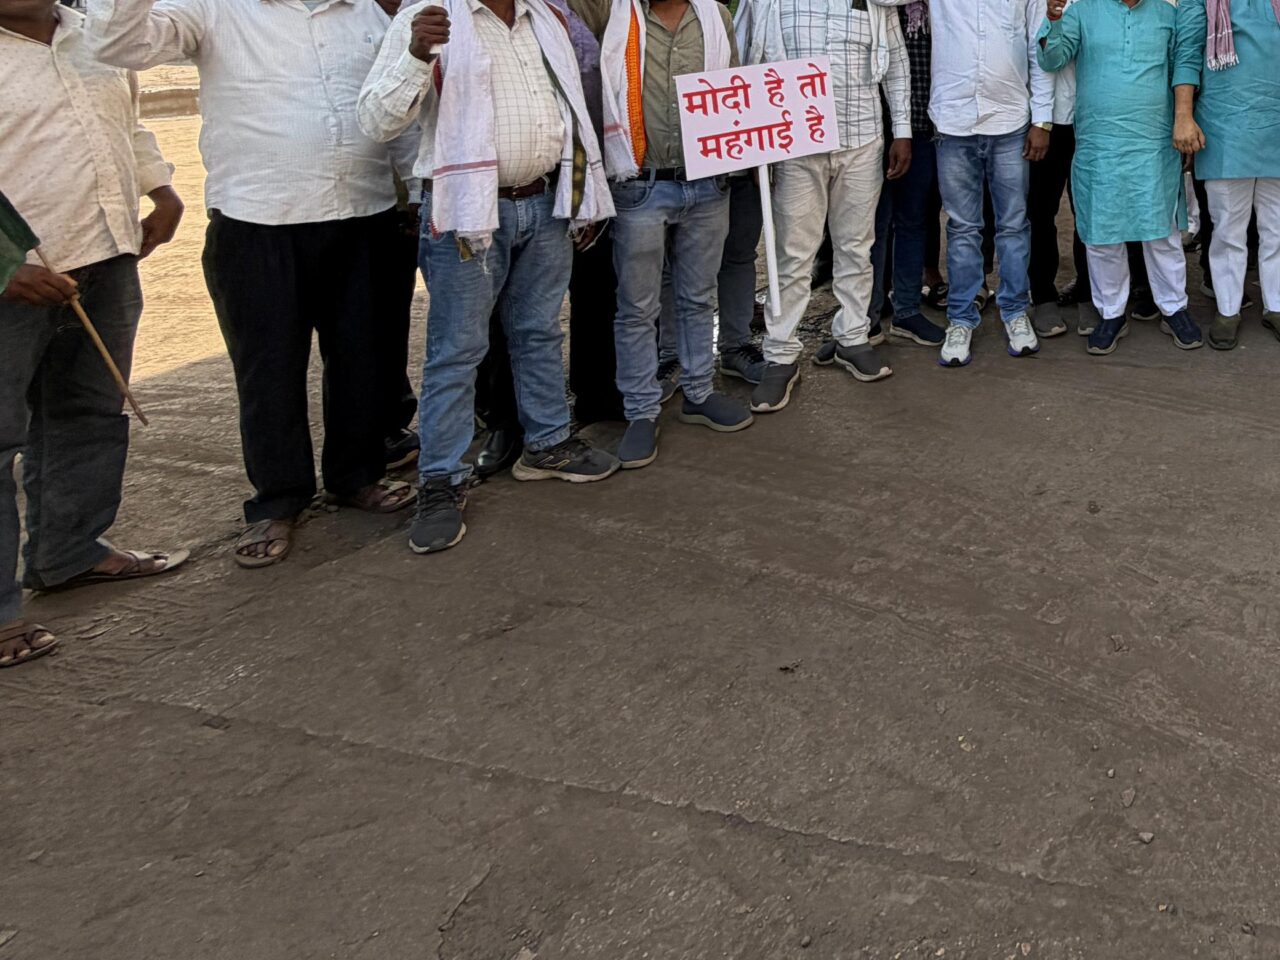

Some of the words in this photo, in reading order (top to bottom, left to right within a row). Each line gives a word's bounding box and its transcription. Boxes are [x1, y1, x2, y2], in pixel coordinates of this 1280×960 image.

[682, 75, 751, 116] मोदी
[764, 68, 784, 108] है
[797, 63, 827, 99] तो
[697, 110, 794, 160] महंगाई
[806, 105, 825, 143] है
